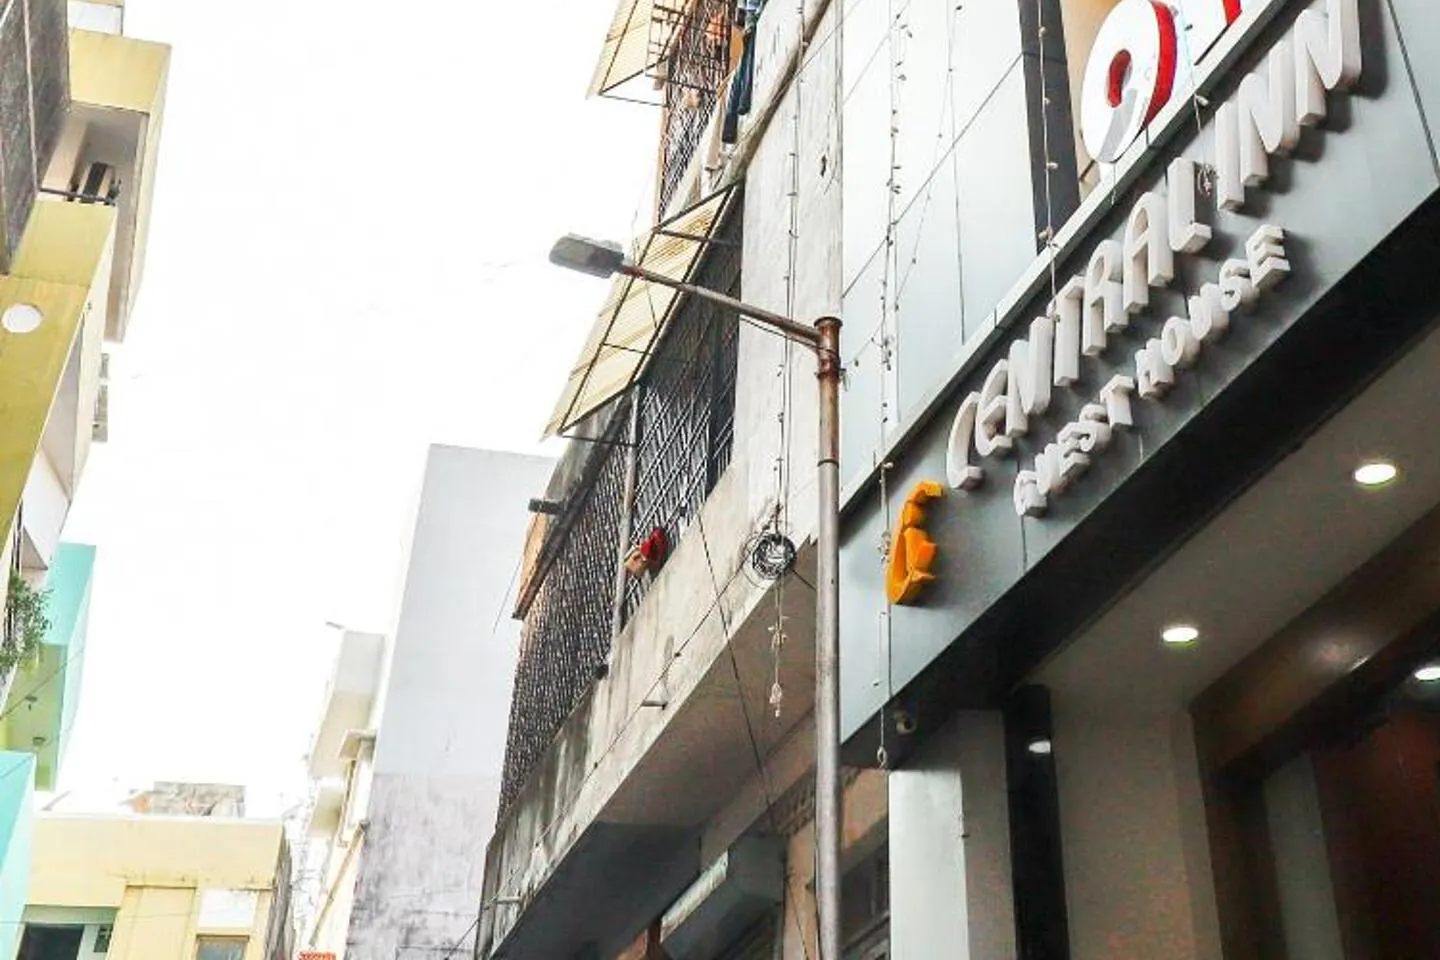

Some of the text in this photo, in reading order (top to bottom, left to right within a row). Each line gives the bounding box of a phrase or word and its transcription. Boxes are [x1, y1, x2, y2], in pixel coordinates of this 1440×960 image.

[947, 157, 1212, 490] CENTRAL
[1014, 224, 1291, 517] GUEST HOUSE
